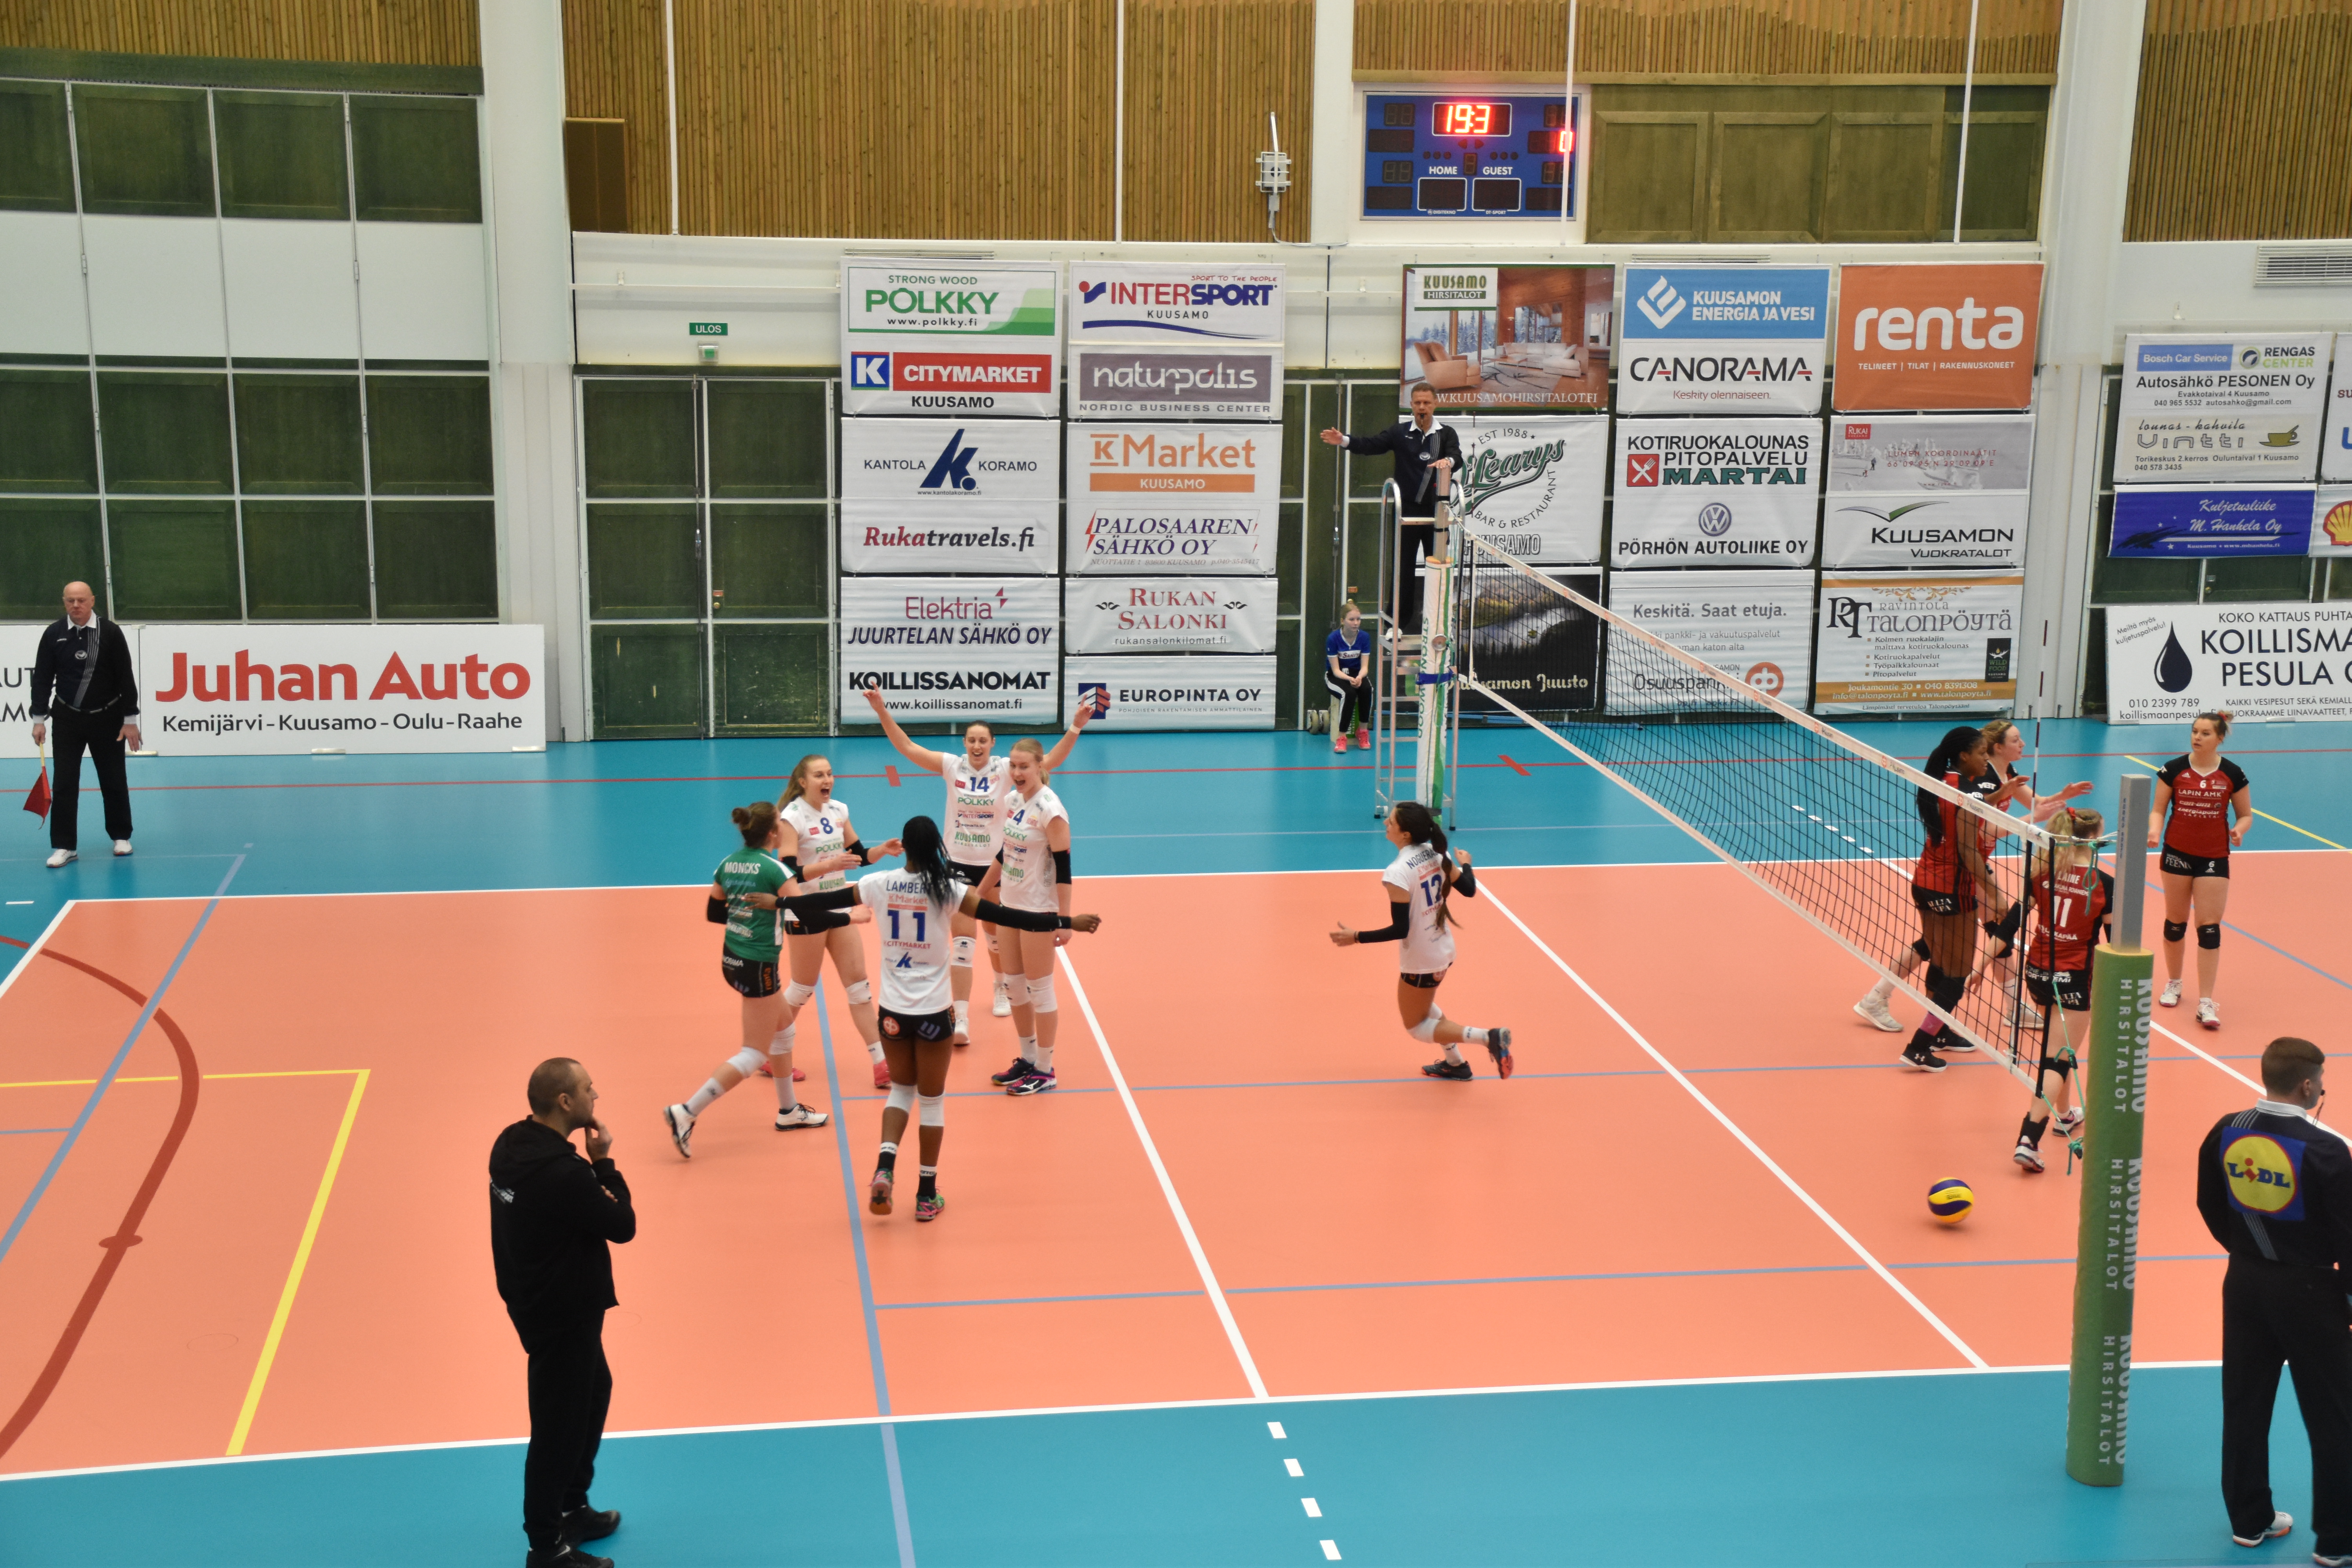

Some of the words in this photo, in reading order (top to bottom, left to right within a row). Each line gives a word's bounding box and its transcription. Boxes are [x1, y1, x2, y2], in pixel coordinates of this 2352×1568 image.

[1429, 166, 1457, 174] HOME
[1483, 167, 1512, 175] GUEST
[889, 276, 935, 284] STRONG
[1424, 275, 1486, 289] KUUSAMO
[1111, 282, 1273, 306] INTERSPORT
[1693, 291, 1780, 305] KUUSAMON
[1147, 310, 1209, 319] KUUSAMO
[1692, 307, 1759, 321] ENERGIA
[1763, 307, 1780, 321] JA
[1780, 307, 1815, 321] VESI
[887, 318, 977, 327] www.polkky.fi
[1854, 297, 2024, 351] renta
[2143, 354, 2172, 363] Bosch
[2264, 347, 2315, 356] RENGAS
[857, 358, 885, 384] K
[904, 365, 1042, 383] CITYMARKET
[1630, 358, 1812, 381] CANORAMA
[2263, 359, 2314, 368] CENTER
[2136, 376, 2213, 388] Autosähkö
[2218, 375, 2290, 387] PESONEN
[2296, 374, 2315, 389] Oy
[912, 396, 994, 408] KUUSAMO
[1673, 390, 1708, 401] Keskity
[1711, 391, 1771, 399] olennaiseen.
[1478, 430, 1497, 445] EST
[1503, 428, 1527, 439] 1988
[1628, 436, 1809, 450] KOTIRUOKALOUNAS
[1123, 433, 1256, 468] Market
[1665, 452, 1808, 465] PITOPALVELU
[864, 460, 926, 470] KANTOLA
[978, 461, 1037, 471] KORAMO
[1140, 479, 1205, 489] KUUSAMO
[1662, 468, 1807, 485] MARTAI
[1475, 510, 1495, 526] BAR
[1511, 469, 1556, 528] RESTAURANT
[2199, 499, 2276, 515] Kuljetusliike
[1093, 518, 1253, 534] PALOSAAREN
[2211, 519, 2260, 531] Hanhela
[2265, 519, 2282, 534] Oy
[864, 526, 1034, 551] Rukatravels.fi
[1872, 528, 2014, 544] KUUSAMON
[1093, 535, 1174, 554] SÄHKÖ
[1182, 539, 1217, 555] OY
[1619, 538, 1688, 555] PÖRHÖN
[1694, 541, 1780, 554] AUTOLIIKE
[1786, 540, 1809, 554] OY
[1910, 549, 2012, 558] VUOKRATALOT
[1129, 588, 1216, 606] RUKAN
[906, 597, 993, 619] Elektria
[1633, 603, 1694, 618] Keskitä.
[1702, 604, 1737, 617] Saat
[1743, 603, 1786, 619] etuja.
[1118, 611, 1227, 630] SALONKI
[2117, 622, 2137, 635] Meiltä
[2139, 615, 2156, 627] myös
[2219, 612, 2254, 623] KOKO
[2259, 612, 2310, 622] KATTAUS
[848, 627, 954, 644] JUURTELAN
[959, 623, 1020, 644] SÄHKÖ
[1027, 628, 1052, 644] OY
[1699, 631, 1706, 640] ja
[1710, 630, 1780, 638] vakuutuspalvelut
[156, 648, 358, 703] Juhan
[369, 651, 530, 701] Auto
[849, 671, 1051, 690] KOILLISSANOMAT
[2222, 661, 2334, 686] PESULA
[1536, 674, 1588, 692] Juusto
[1120, 689, 1229, 702] EUROPINTA
[1236, 689, 1261, 701] OY
[2129, 699, 2148, 708] 010
[2151, 699, 2177, 708] 2399
[2181, 698, 2200, 707] 789
[2297, 696, 2316, 704] SEKÄ
[970, 777, 989, 792] 14
[1013, 809, 1025, 825] 4
[820, 817, 833, 834] 8
[955, 831, 990, 842] KUUSAMO
[725, 862, 761, 874] MONCKS
[887, 910, 925, 942] 11
[2114, 979, 2132, 1112] HIRSITALOT
[2105, 1158, 2123, 1289] HIRSITALOT
[2099, 1336, 2115, 1465] HIRSITALOT
